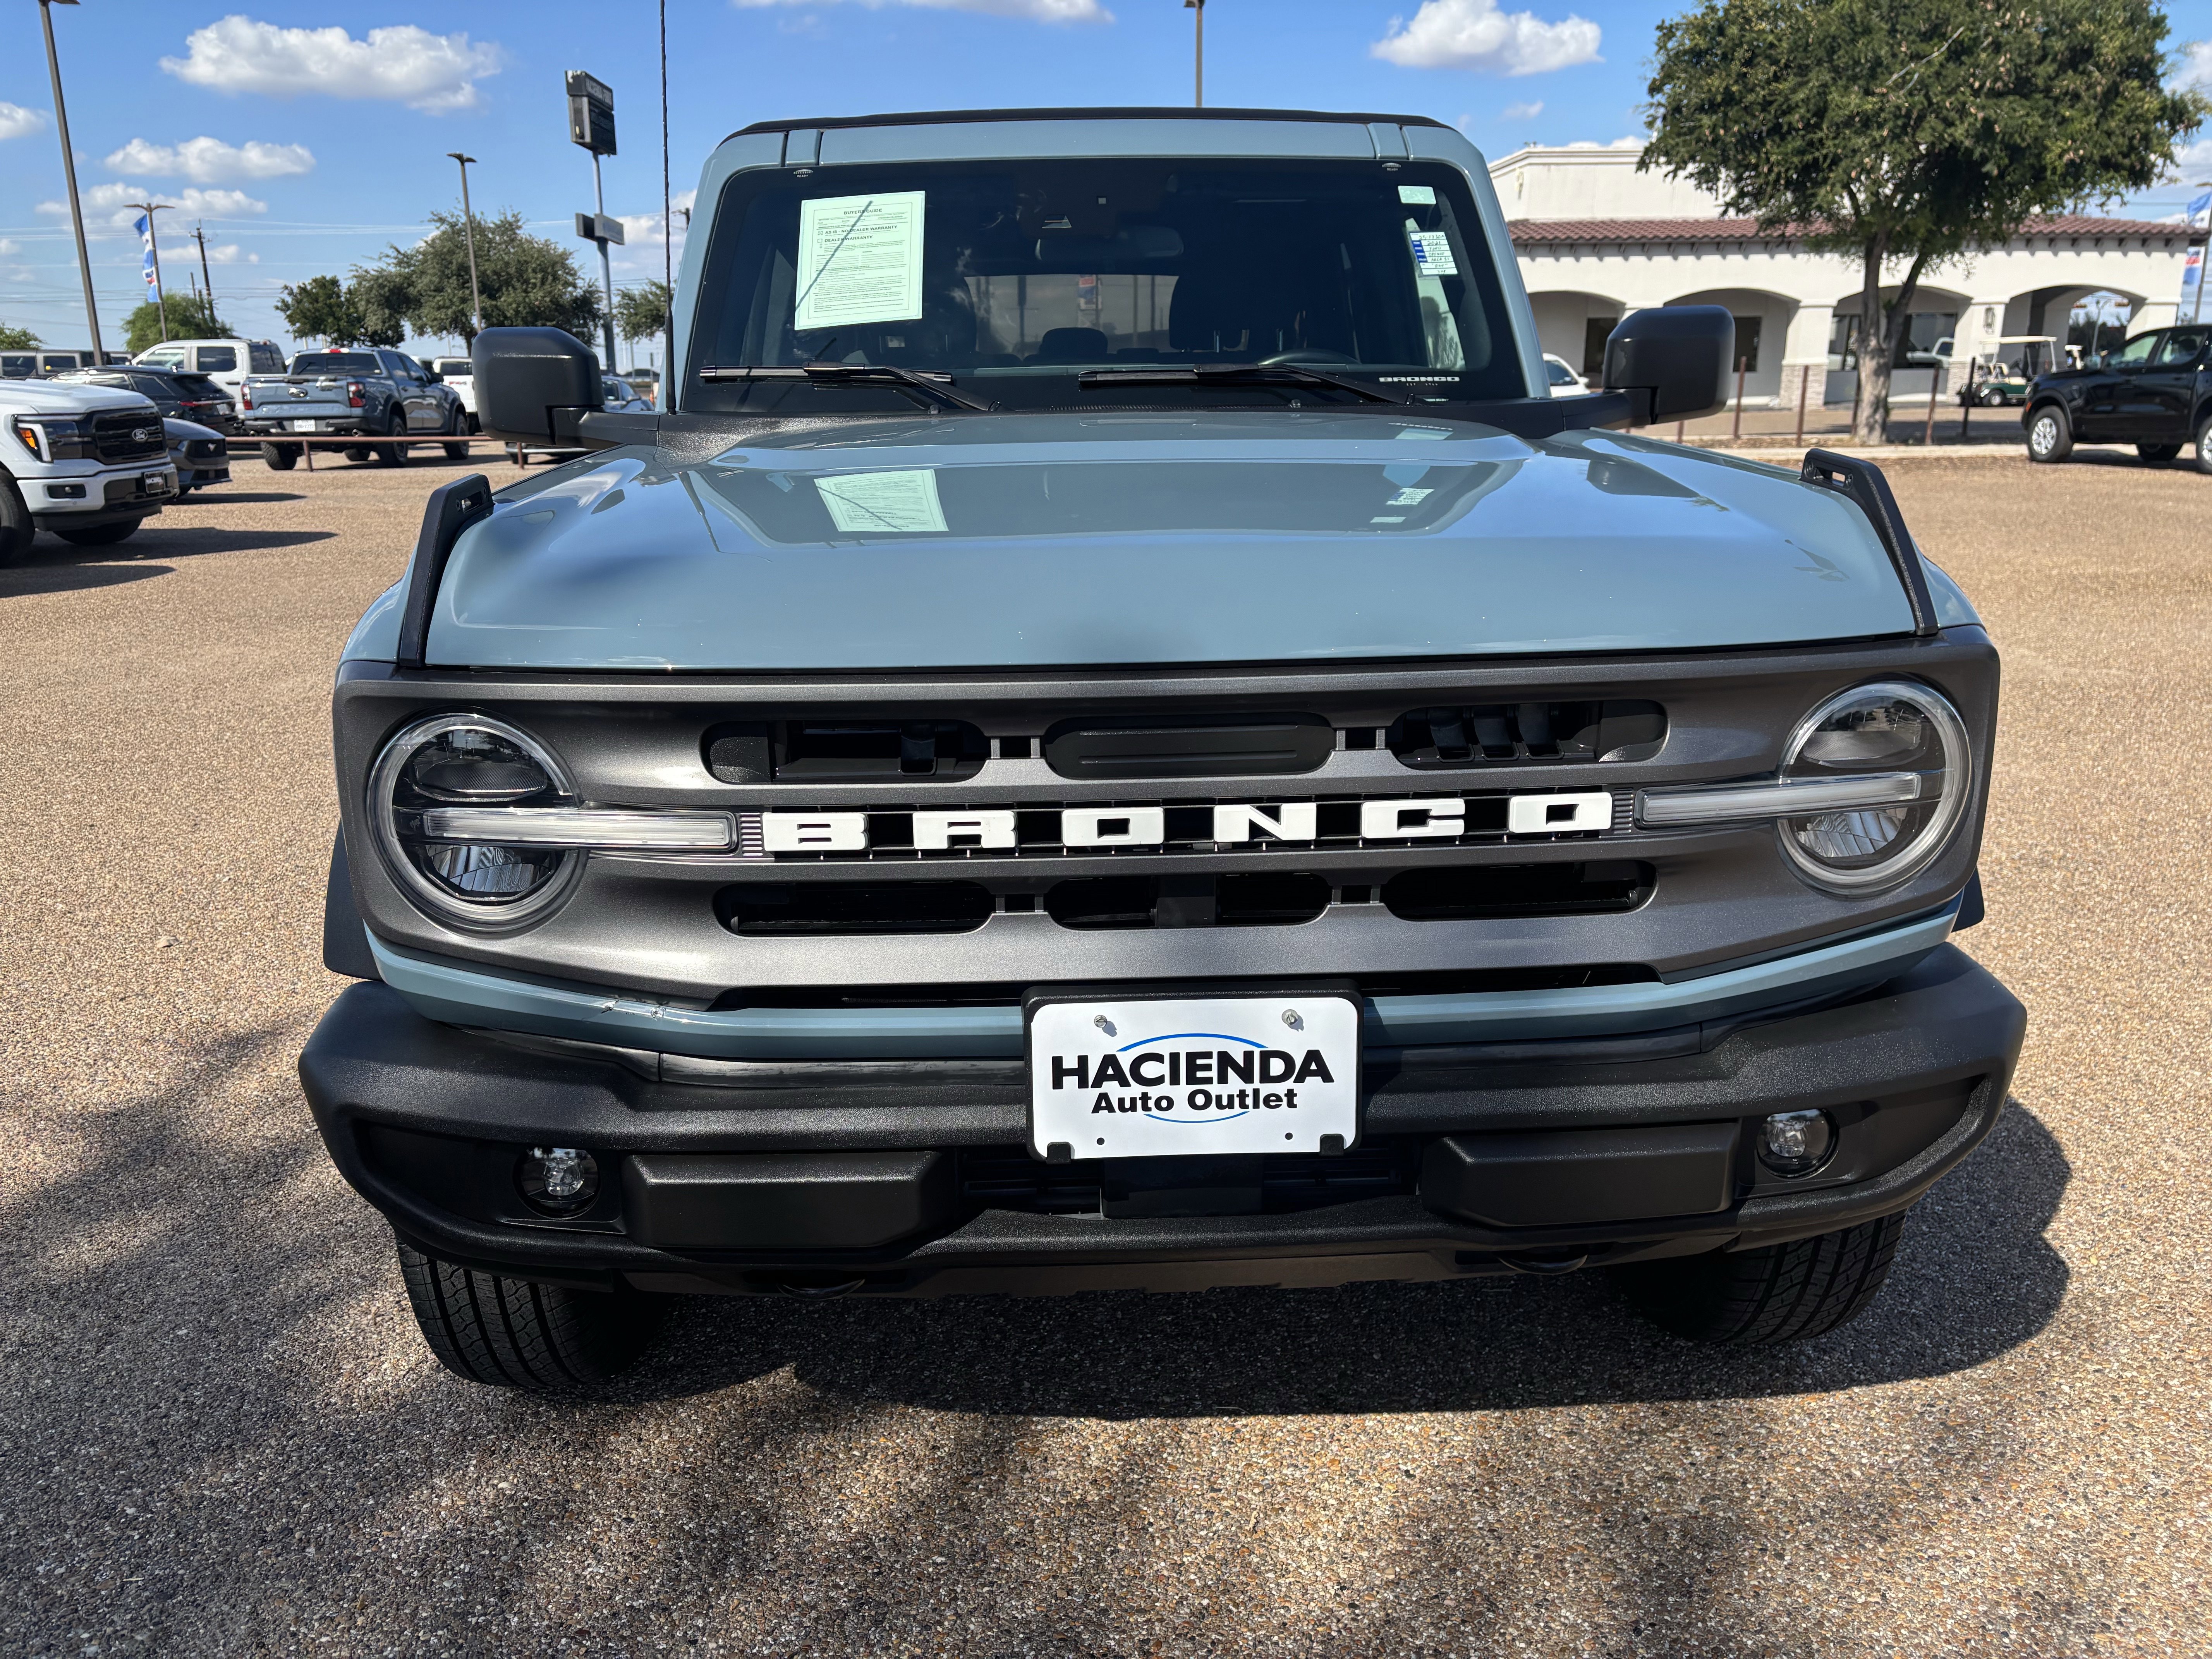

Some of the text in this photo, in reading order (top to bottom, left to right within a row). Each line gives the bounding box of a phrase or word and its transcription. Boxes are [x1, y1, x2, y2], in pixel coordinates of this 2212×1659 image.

[762, 792, 1612, 852] BRONCO
[1052, 1049, 1334, 1089] HACIENDA
[1091, 1087, 1298, 1114] Auto Outlet
